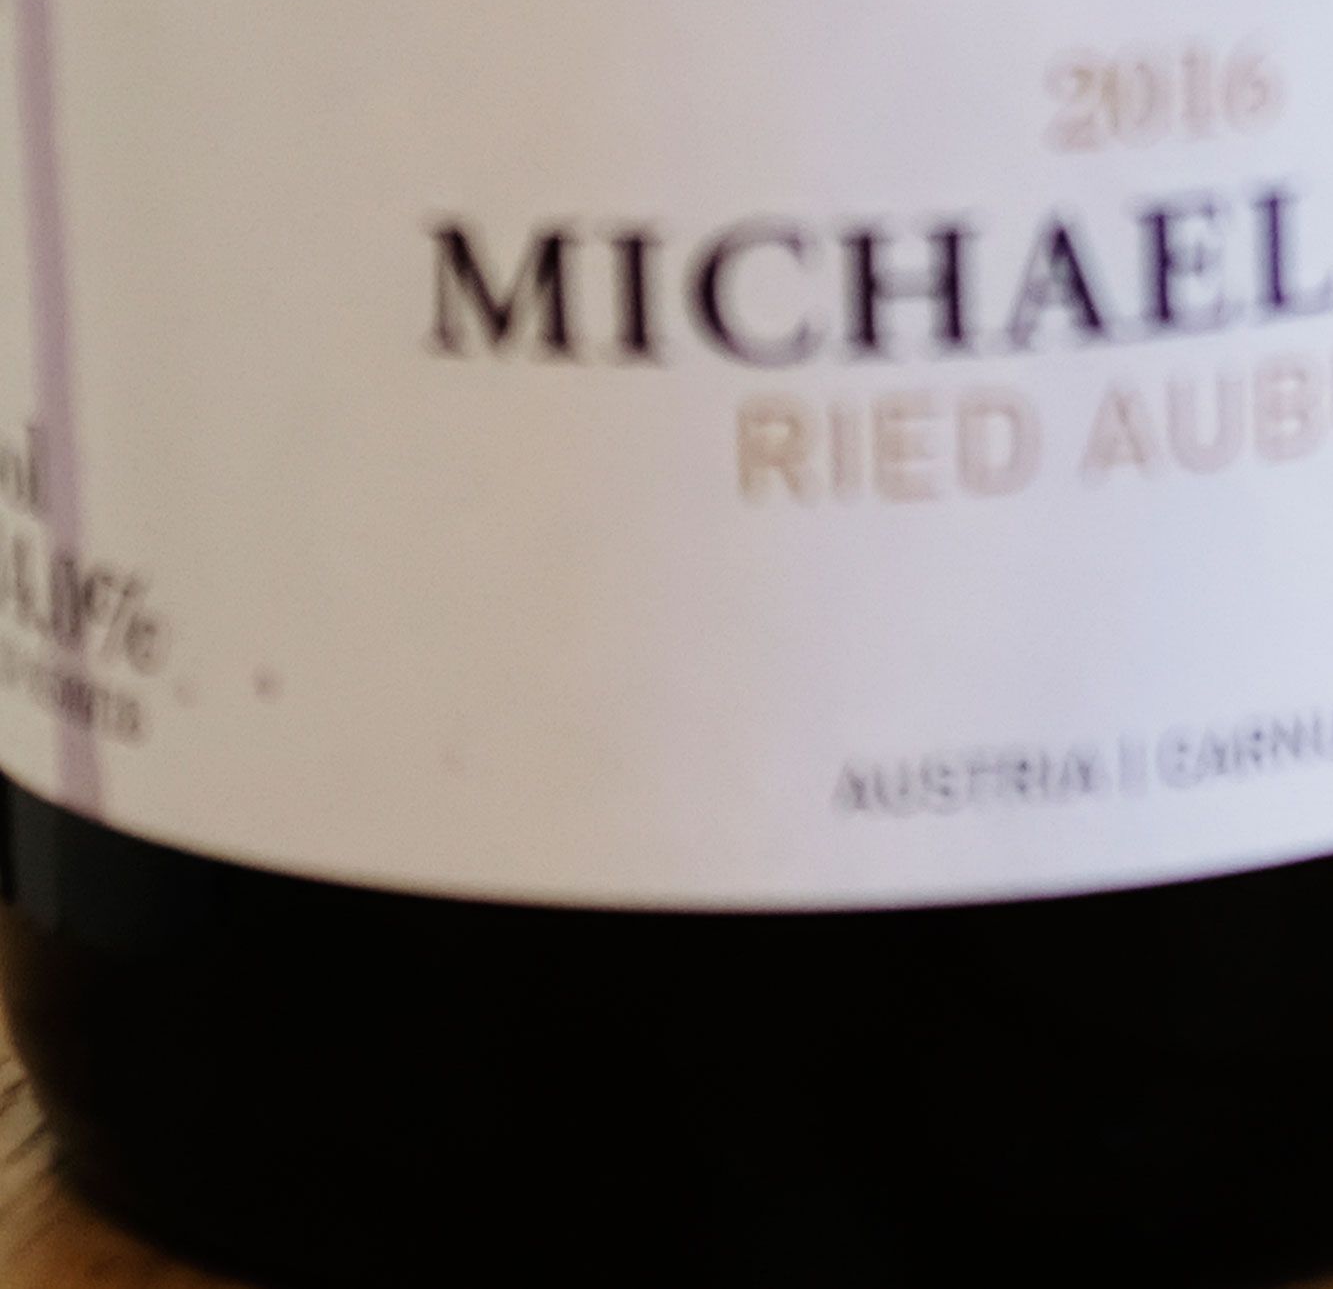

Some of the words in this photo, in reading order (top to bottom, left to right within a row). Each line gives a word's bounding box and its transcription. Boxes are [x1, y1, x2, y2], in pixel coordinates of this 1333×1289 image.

[1043, 36, 1284, 153] 2016
[734, 389, 1044, 504] RIED
[832, 741, 1112, 815] AUSTRIA
